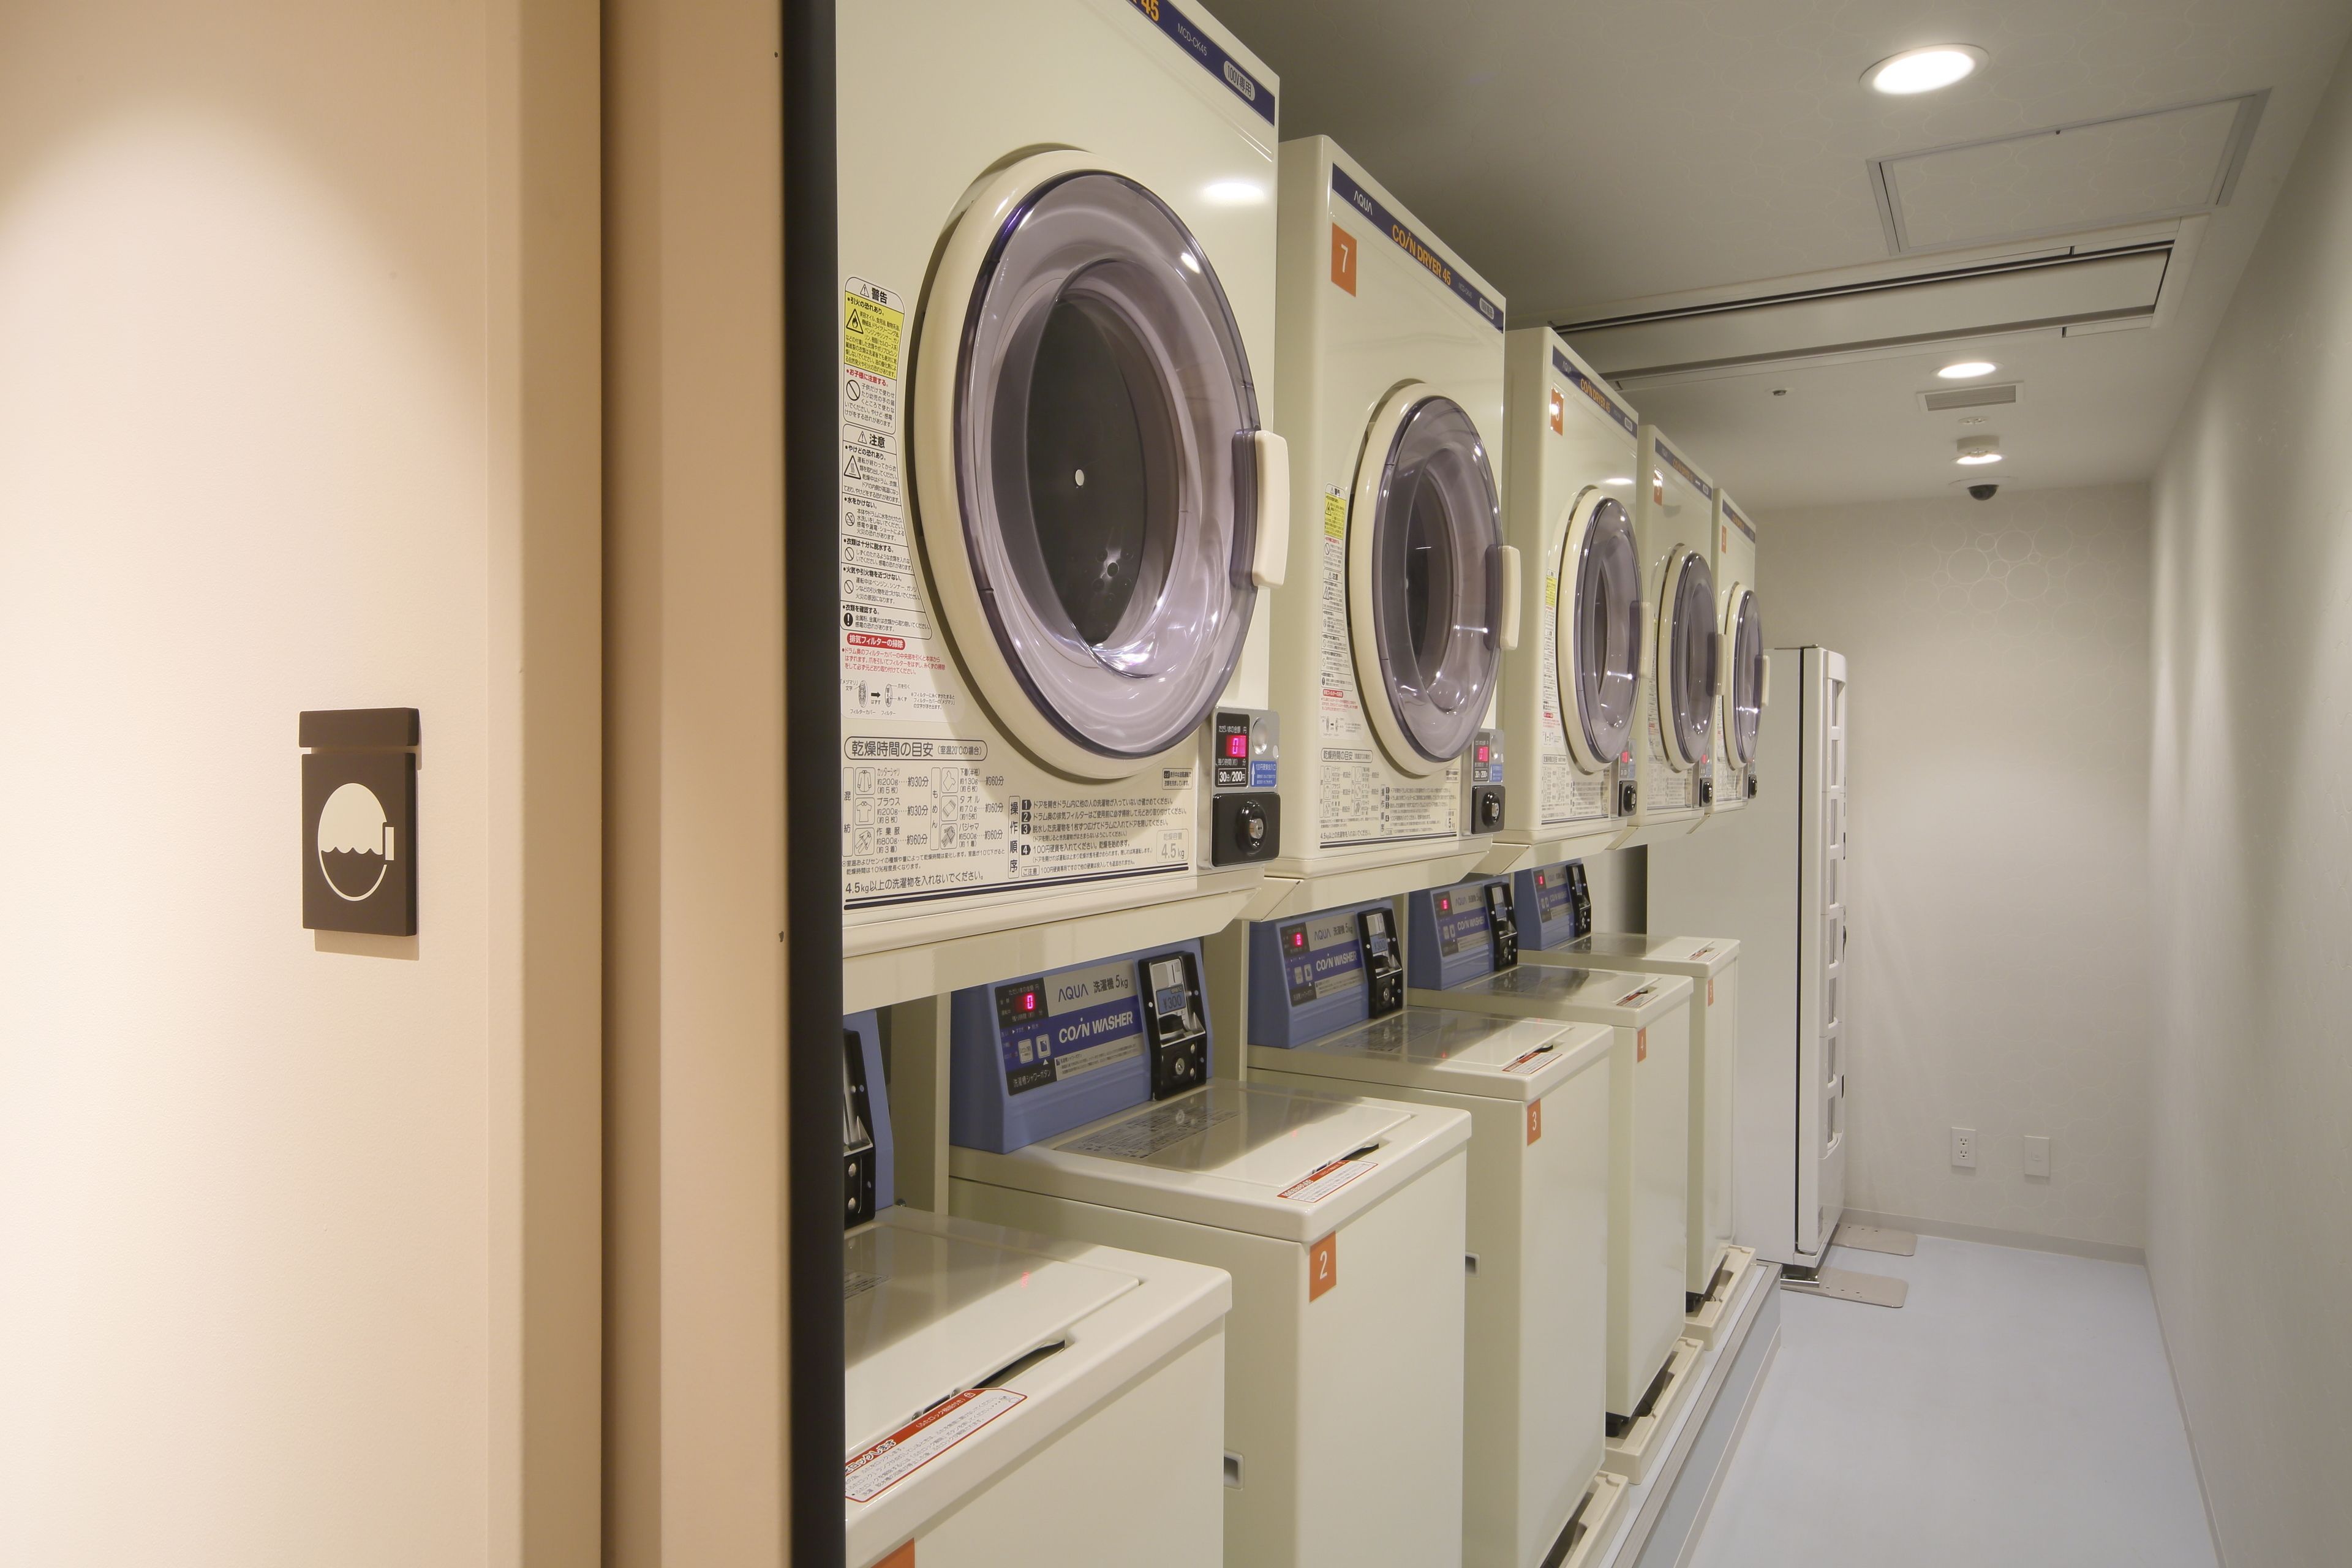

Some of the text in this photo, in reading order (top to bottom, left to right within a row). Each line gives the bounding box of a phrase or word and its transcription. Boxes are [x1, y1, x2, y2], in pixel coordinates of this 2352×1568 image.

[1178, 23, 1207, 56] MCD-CK45
[1227, 65, 1252, 97] 100V専用
[1354, 190, 1373, 215] AQUA
[1341, 244, 1348, 273] 7
[1417, 244, 1441, 278] DRYER
[1442, 269, 1451, 285] 45
[872, 287, 887, 304] 警告
[869, 434, 885, 448] 注意
[847, 497, 877, 509] 水をかけない。
[846, 605, 879, 615] 衣類を確認する。
[849, 635, 903, 648] 排気フィルターの掃除
[852, 741, 933, 757] 乾燥時間の目安
[1232, 737, 1238, 755] 0
[877, 777, 929, 787] 約200g 約30分
[960, 775, 1004, 786] 約130g 約60分
[1219, 771, 1245, 782] 30分/200円
[877, 805, 928, 816] 約200g 約30分
[985, 802, 1003, 813] 約60分
[959, 823, 979, 831] パジャマ
[876, 834, 927, 846] 約800g 約60分
[959, 829, 1003, 841] 約500g 約60分
[1009, 802, 1019, 873] 操作順序
[845, 870, 984, 894] 4.5kg以上の洗濯物を入れないでください。
[1314, 928, 1331, 941] AQUA
[1334, 951, 1357, 966] WASHER
[1058, 974, 1128, 1002] AQUA 洗濯機 5kg
[1027, 995, 1033, 1009] 0
[1092, 1011, 1133, 1035] WASHER
[1532, 1111, 1537, 1131] 3
[1319, 1251, 1328, 1280] 2
